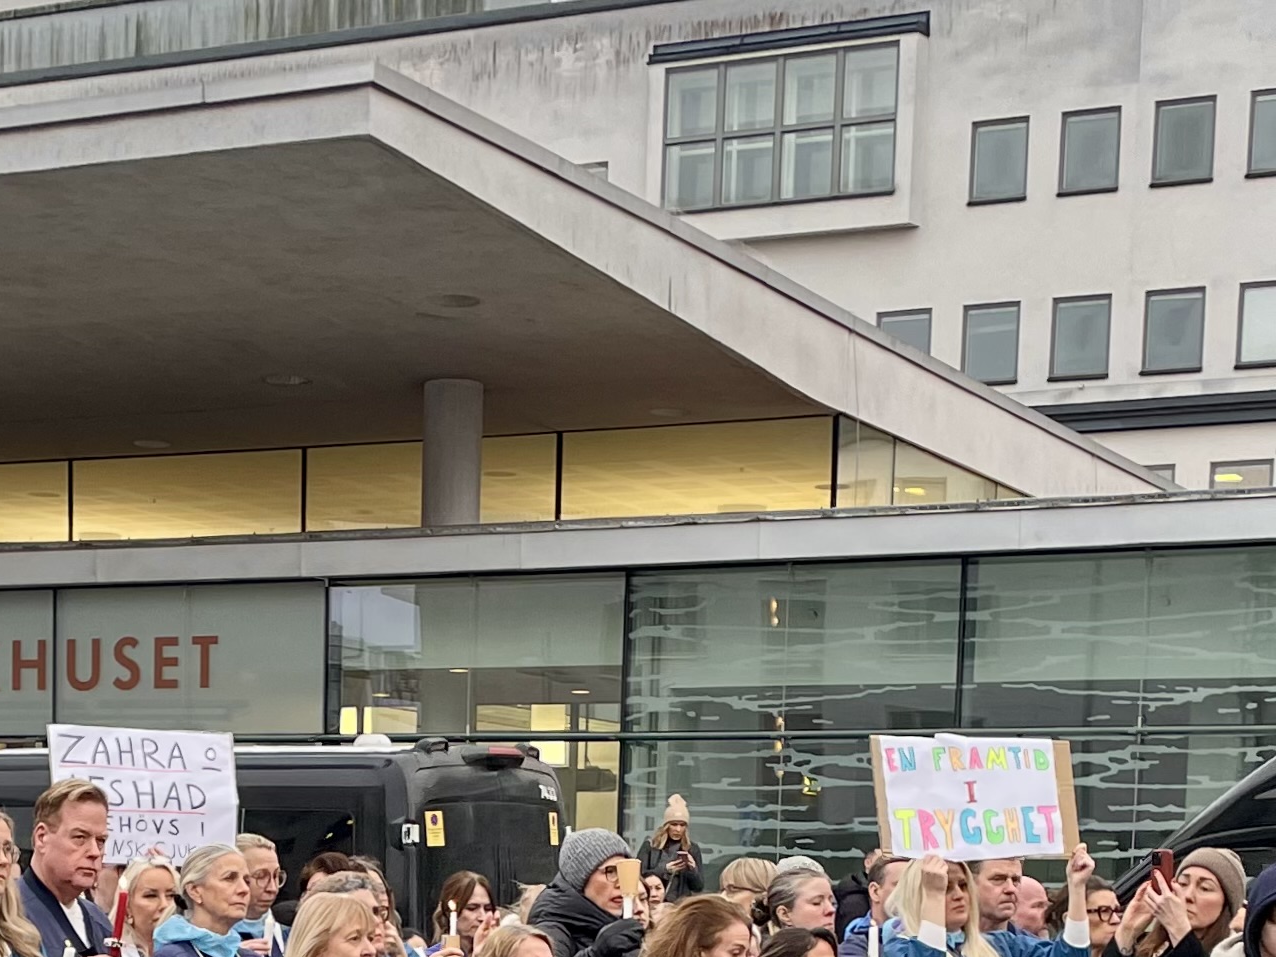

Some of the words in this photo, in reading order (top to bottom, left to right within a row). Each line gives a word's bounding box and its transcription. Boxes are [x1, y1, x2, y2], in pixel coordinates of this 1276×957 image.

[57, 733, 187, 770] ZAHRA
[885, 747, 916, 772] EN
[932, 746, 1050, 771] FRAMTID
[71, 774, 206, 811] SHAD
[964, 780, 977, 803] I
[106, 815, 179, 836] EHÖVS
[894, 805, 1057, 850] TRYGGHET
